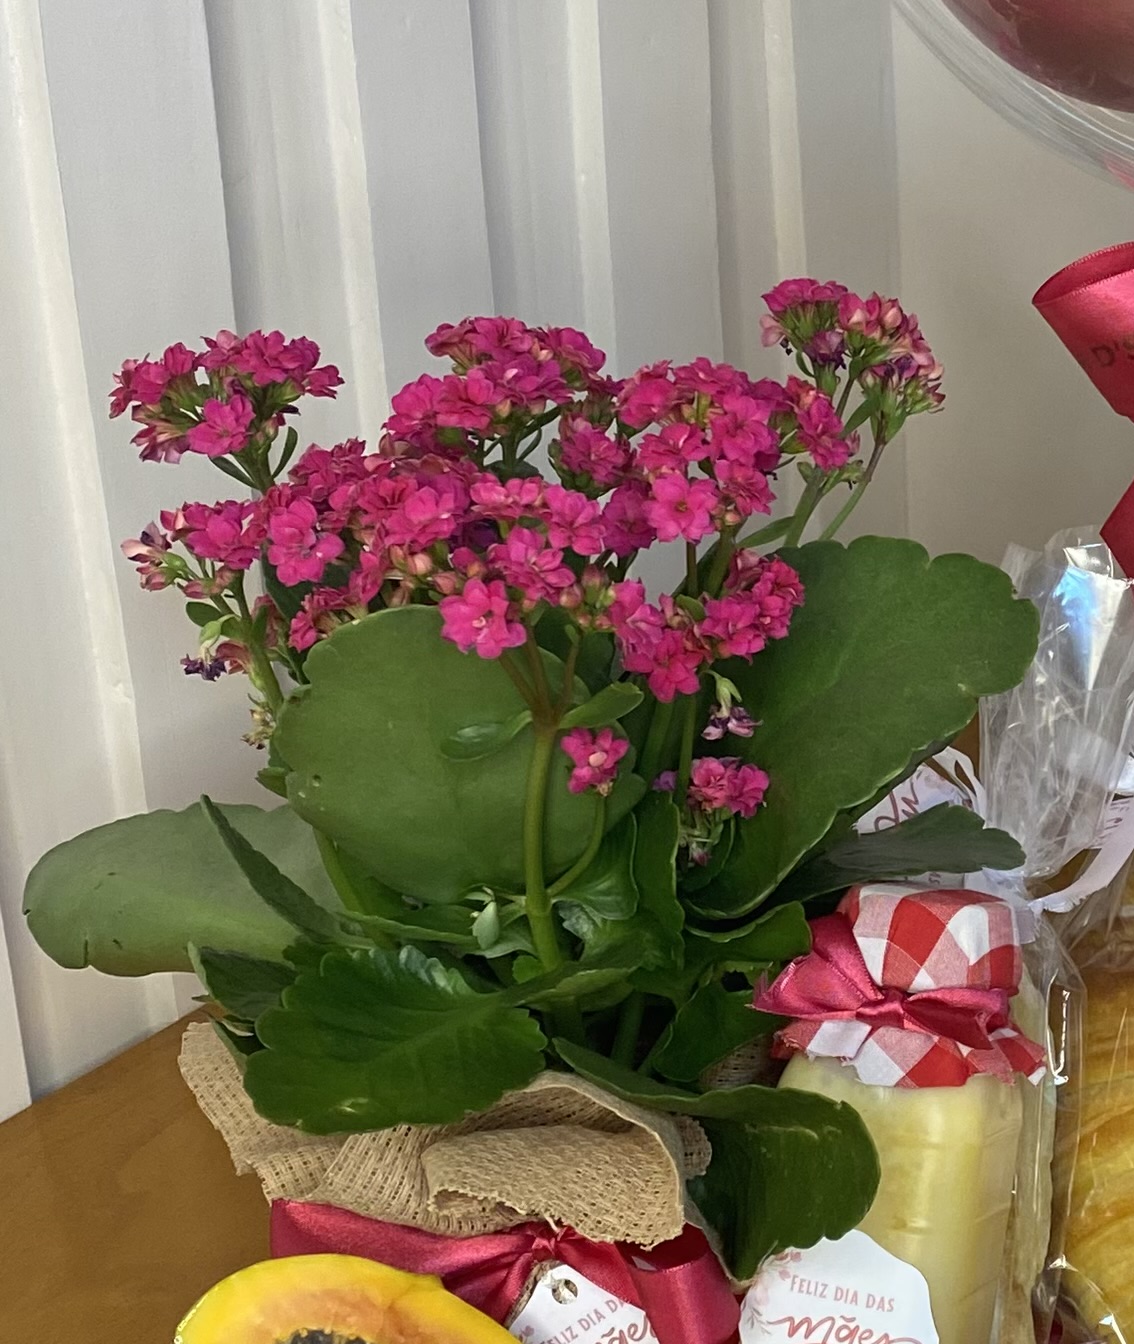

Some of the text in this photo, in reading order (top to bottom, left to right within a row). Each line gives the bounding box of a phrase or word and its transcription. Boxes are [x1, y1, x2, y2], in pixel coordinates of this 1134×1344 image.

[790, 1274, 895, 1313] FELIZ DIA DAS
[577, 1308, 606, 1332] DIA
